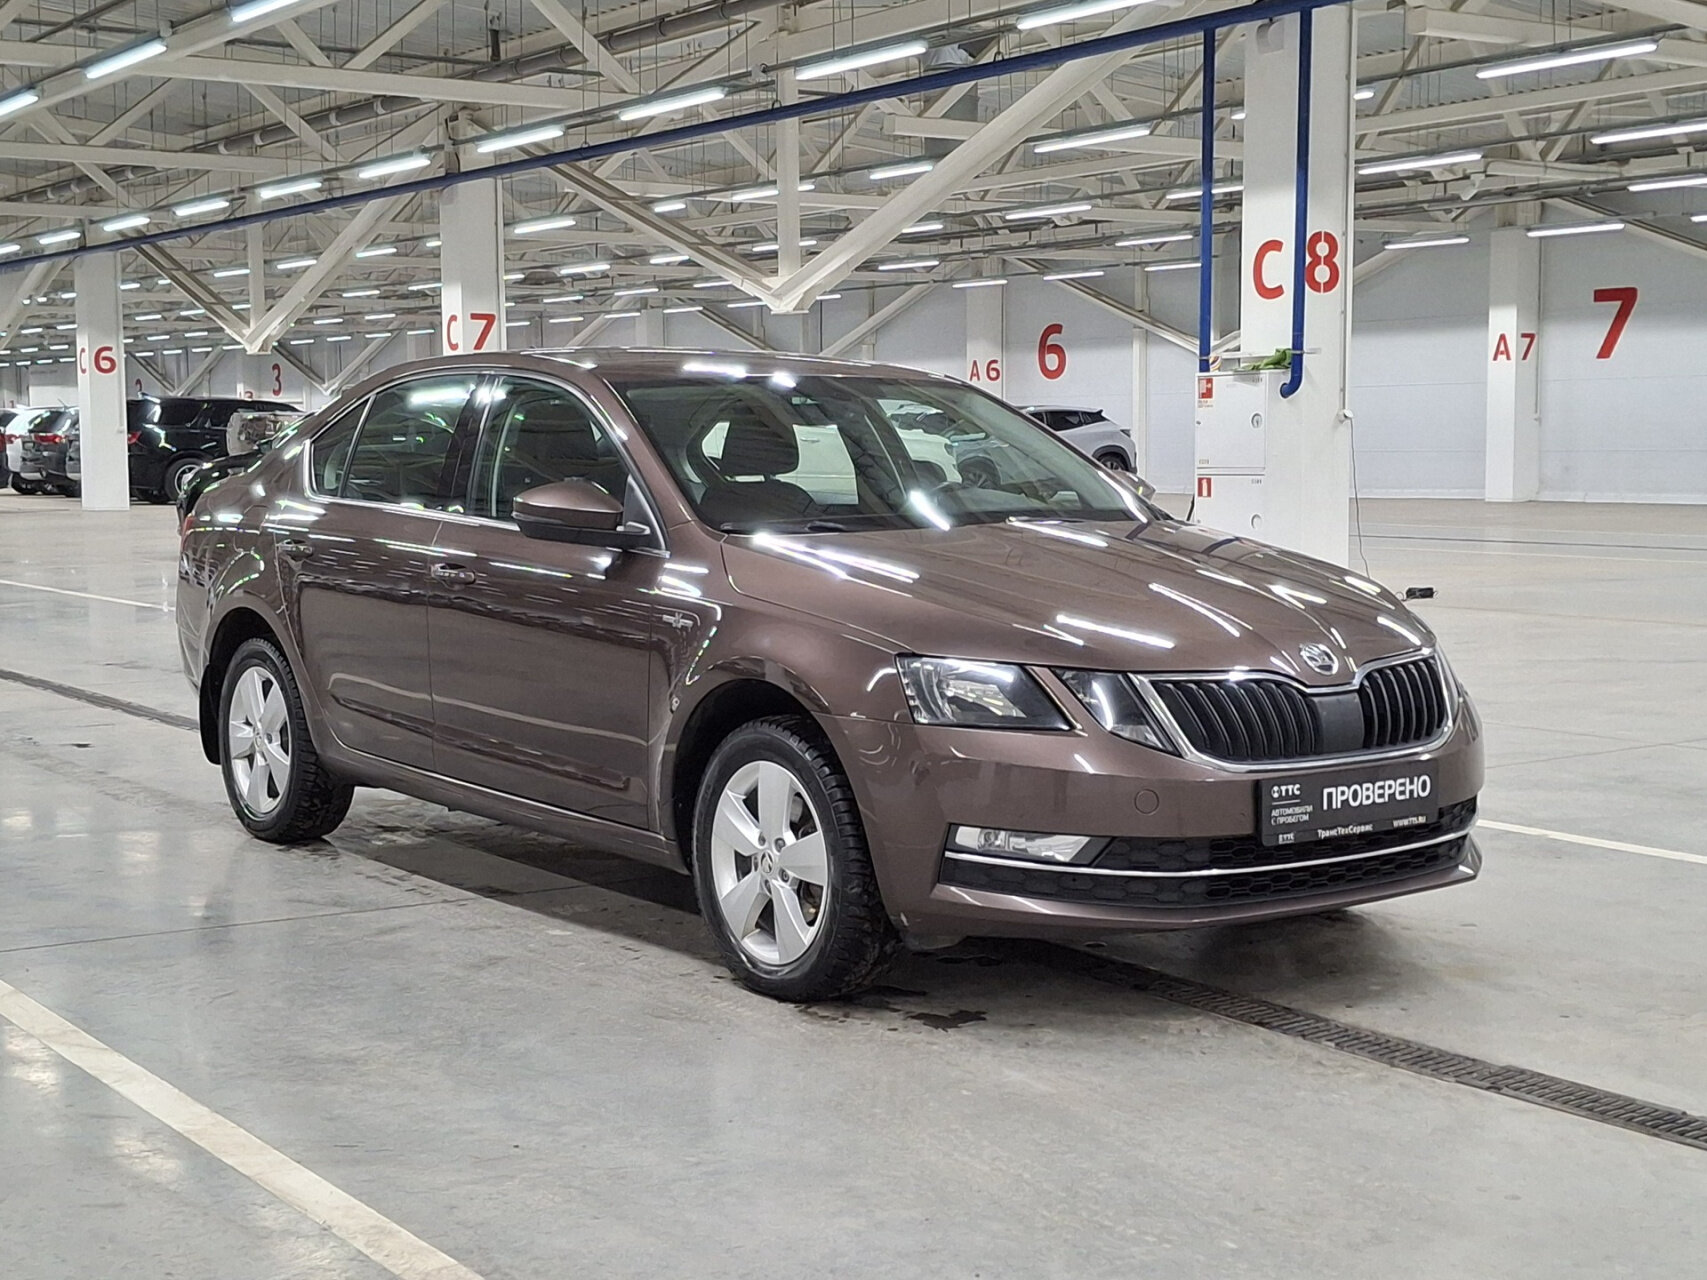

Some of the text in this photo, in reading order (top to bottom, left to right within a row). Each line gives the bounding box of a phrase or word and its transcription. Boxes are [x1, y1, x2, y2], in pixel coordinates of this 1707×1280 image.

[1306, 231, 1341, 293] 8
[469, 312, 497, 351] 7
[1594, 287, 1639, 360] 7
[93, 346, 117, 375] 6
[1037, 324, 1068, 381] 6
[1522, 332, 1537, 360] 7
[271, 363, 282, 397] 3
[985, 359, 1000, 382] 6
[1322, 774, 1431, 811] ПРОВЕРЕНО
[1317, 824, 1374, 840] ТрансТехСервис
